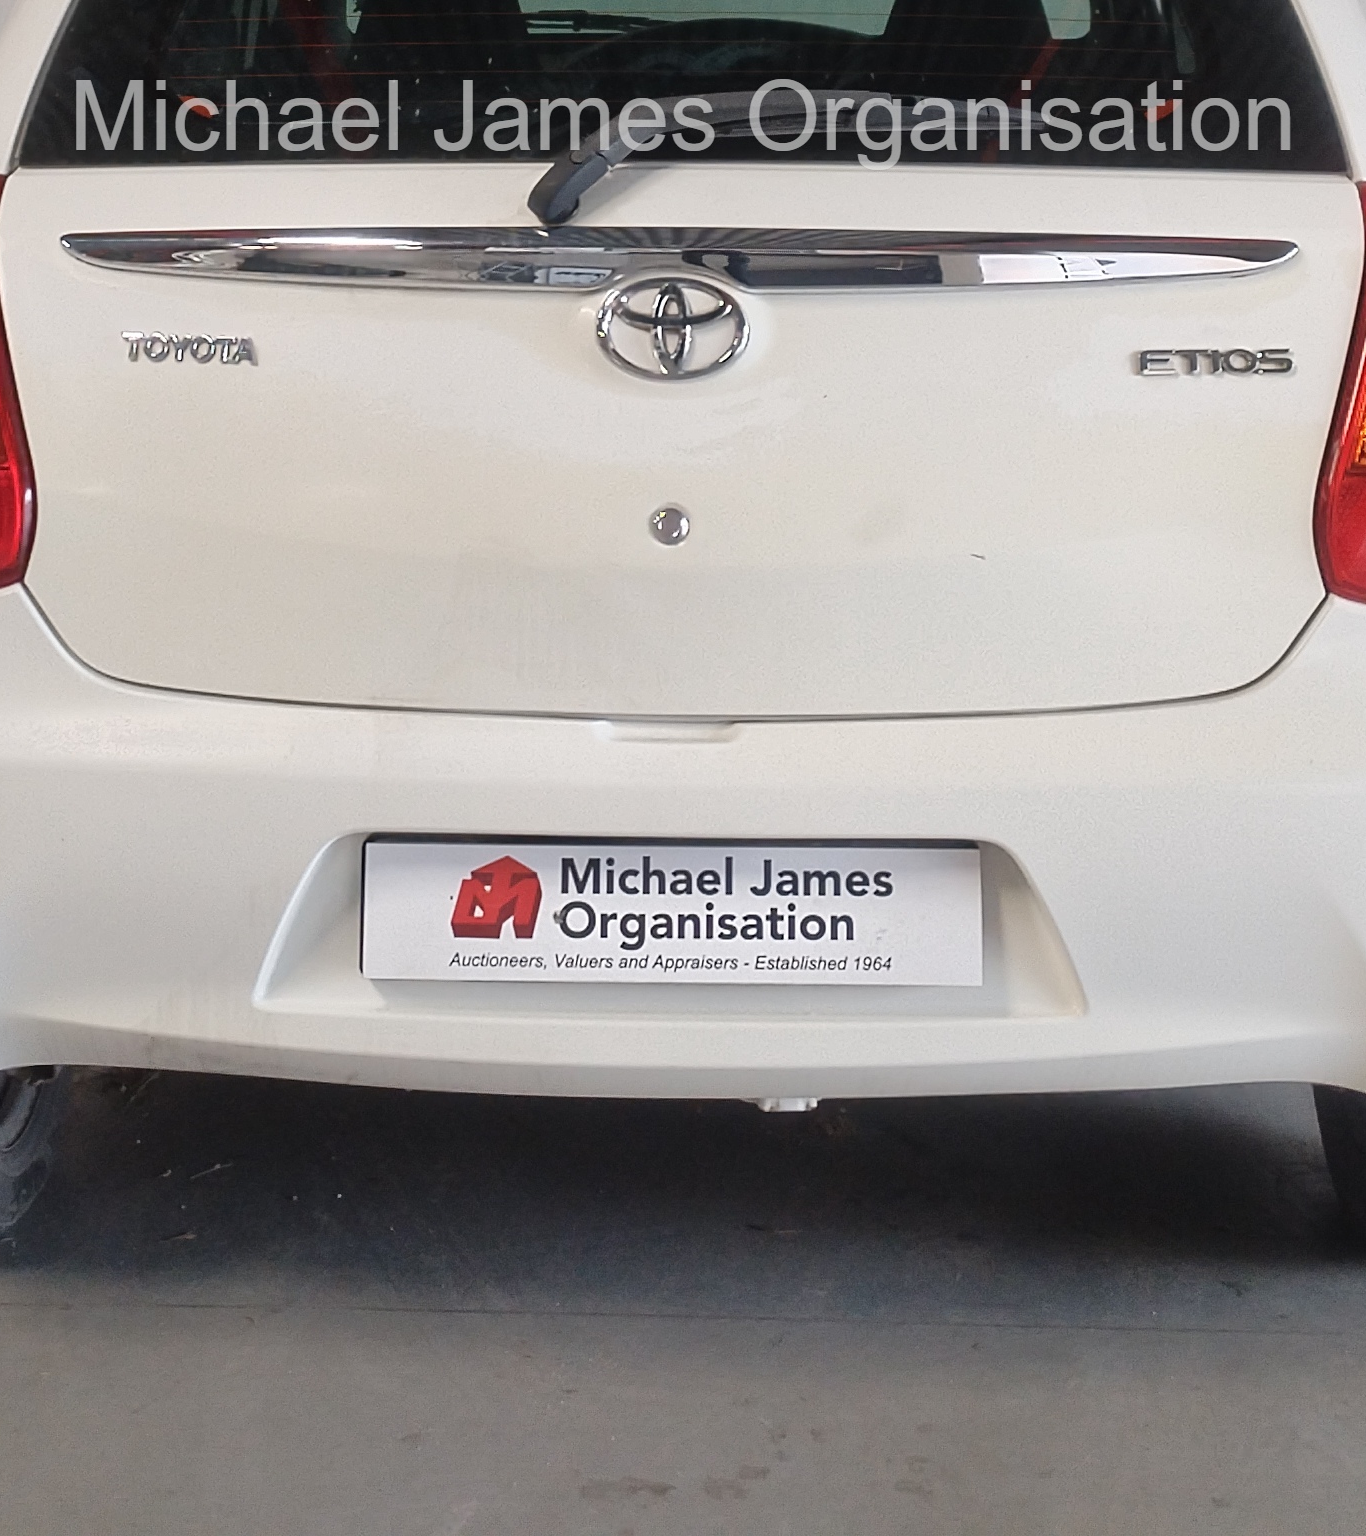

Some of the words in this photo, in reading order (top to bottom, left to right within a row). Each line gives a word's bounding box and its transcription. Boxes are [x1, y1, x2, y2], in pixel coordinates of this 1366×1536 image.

[121, 331, 258, 366] TOYOTA
[1139, 348, 1294, 376] ETIOS
[561, 856, 733, 895] Michael
[750, 859, 893, 896] James
[559, 901, 854, 950] Organisation
[449, 952, 546, 969] Auctioneers,
[556, 954, 613, 968] Valuers
[619, 955, 649, 968] and
[652, 955, 738, 972] Appraisers
[755, 955, 848, 970] Established
[855, 956, 891, 971] 1964
